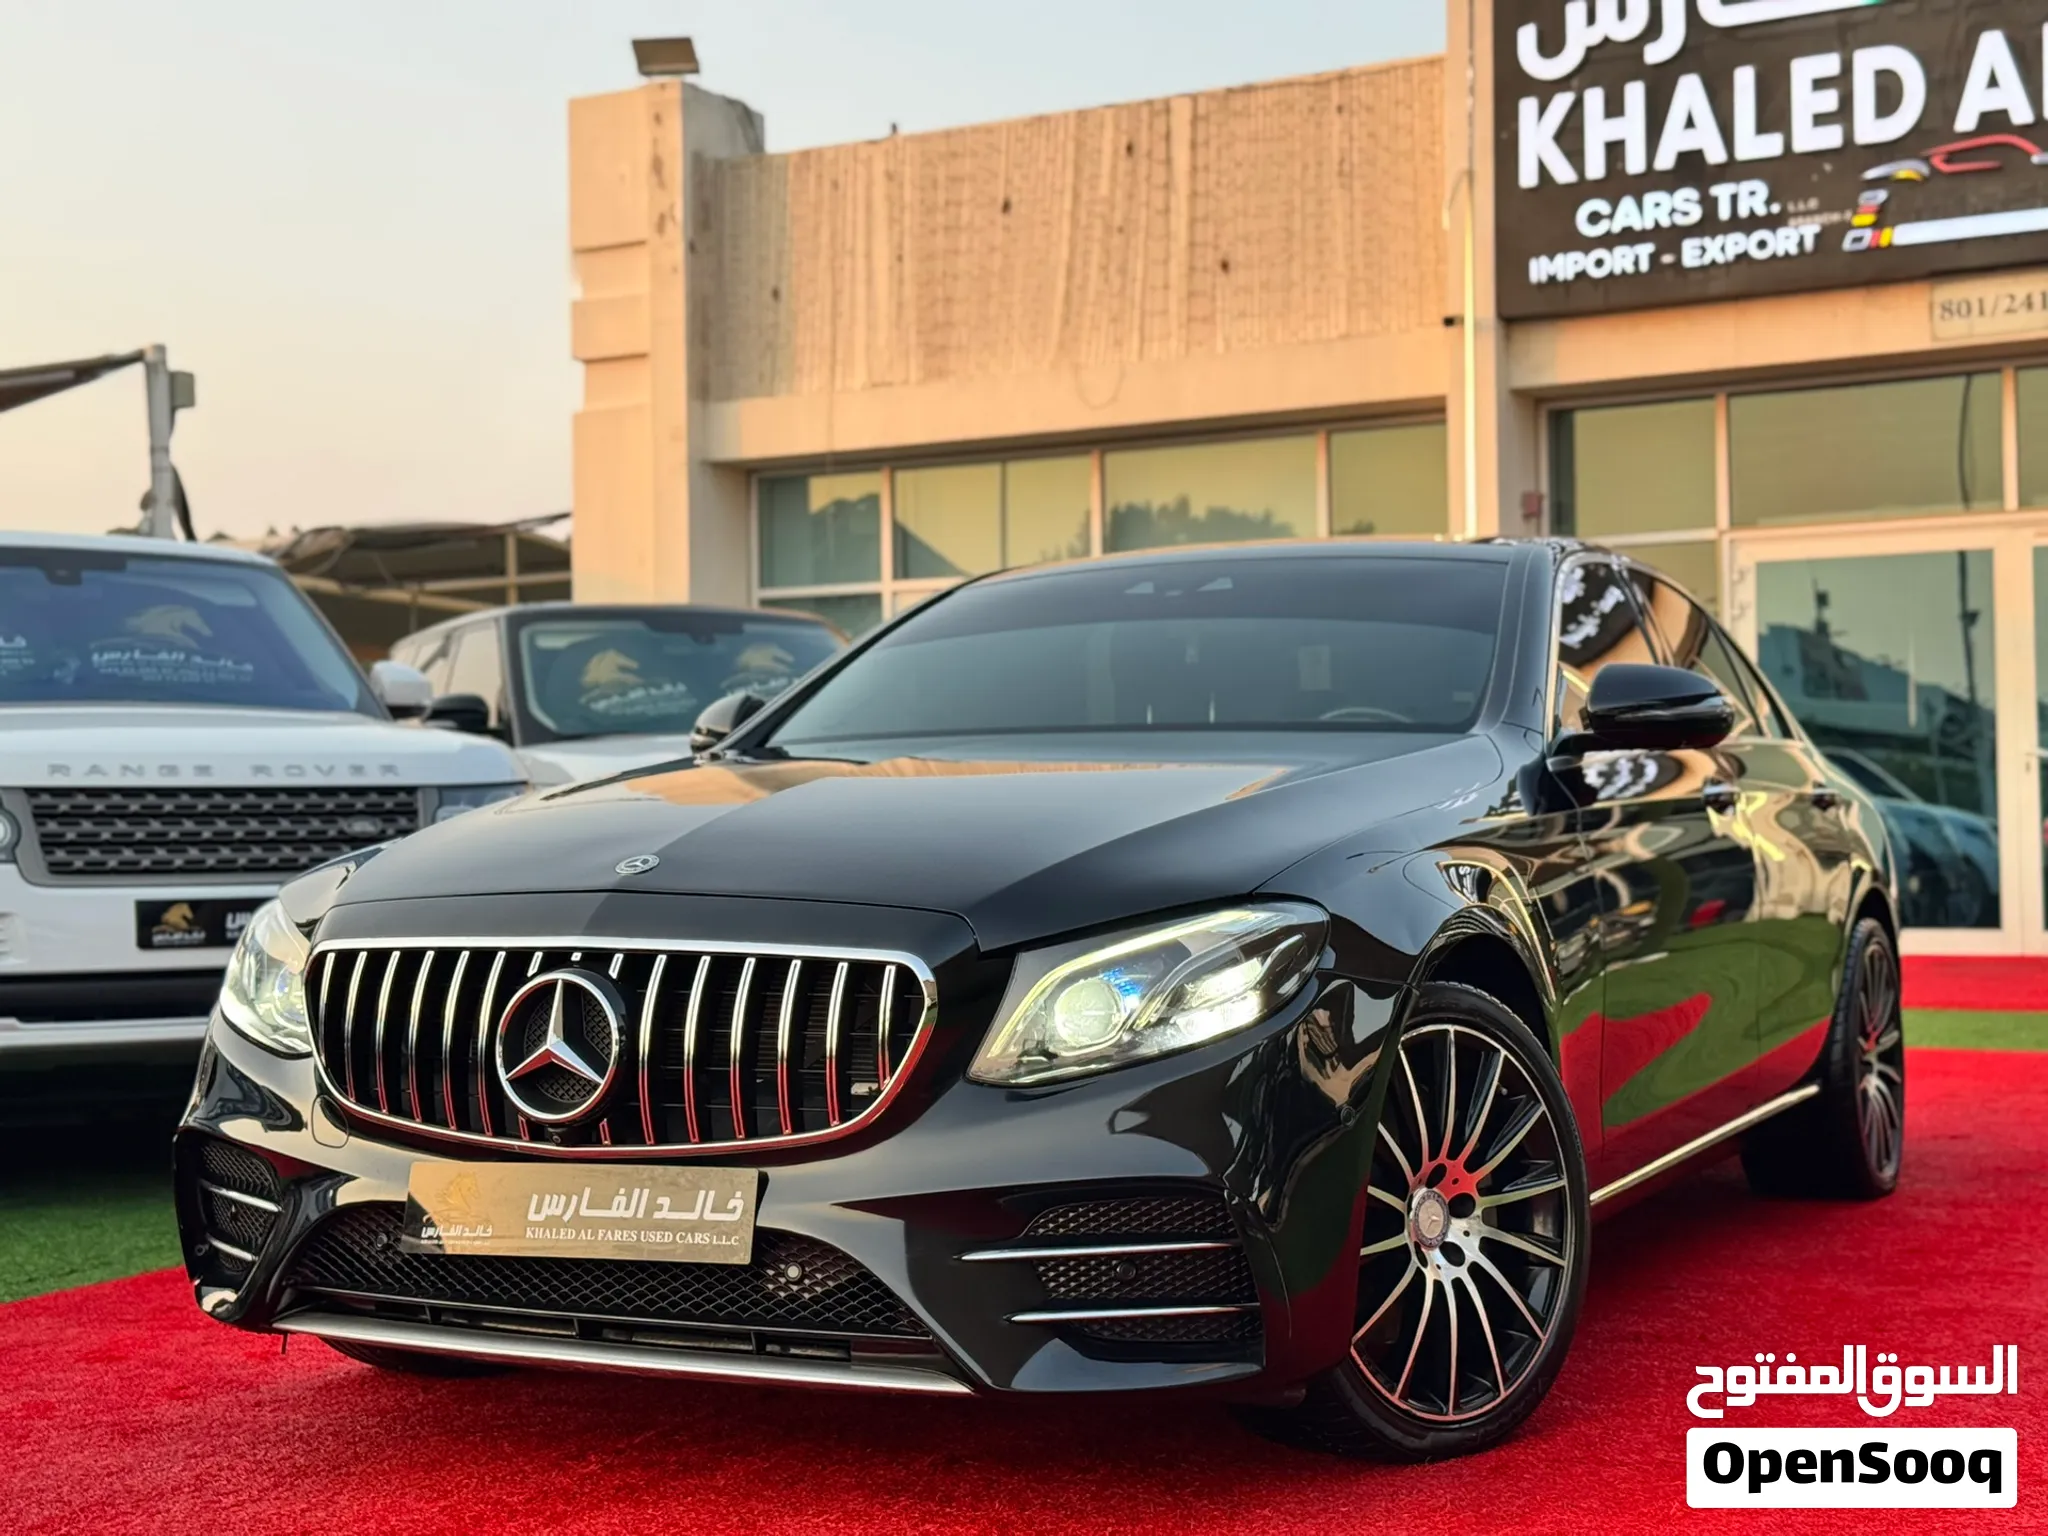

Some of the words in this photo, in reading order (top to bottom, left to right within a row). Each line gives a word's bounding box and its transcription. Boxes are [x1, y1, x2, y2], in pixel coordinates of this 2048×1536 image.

[1518, 44, 1926, 189] KHALED
[1953, 20, 2048, 133] A
[1575, 187, 1703, 237] CARS
[1709, 179, 1781, 221] TR.
[1528, 242, 1656, 285] IMPORT
[1681, 224, 1822, 269] EXPORT
[48, 763, 214, 778] RANGE
[251, 763, 402, 778] ROVER
[526, 1227, 576, 1241] KHALED
[578, 1228, 596, 1241] AL
[597, 1229, 638, 1243] FARES
[640, 1231, 674, 1244] USED
[675, 1232, 711, 1245] CARS
